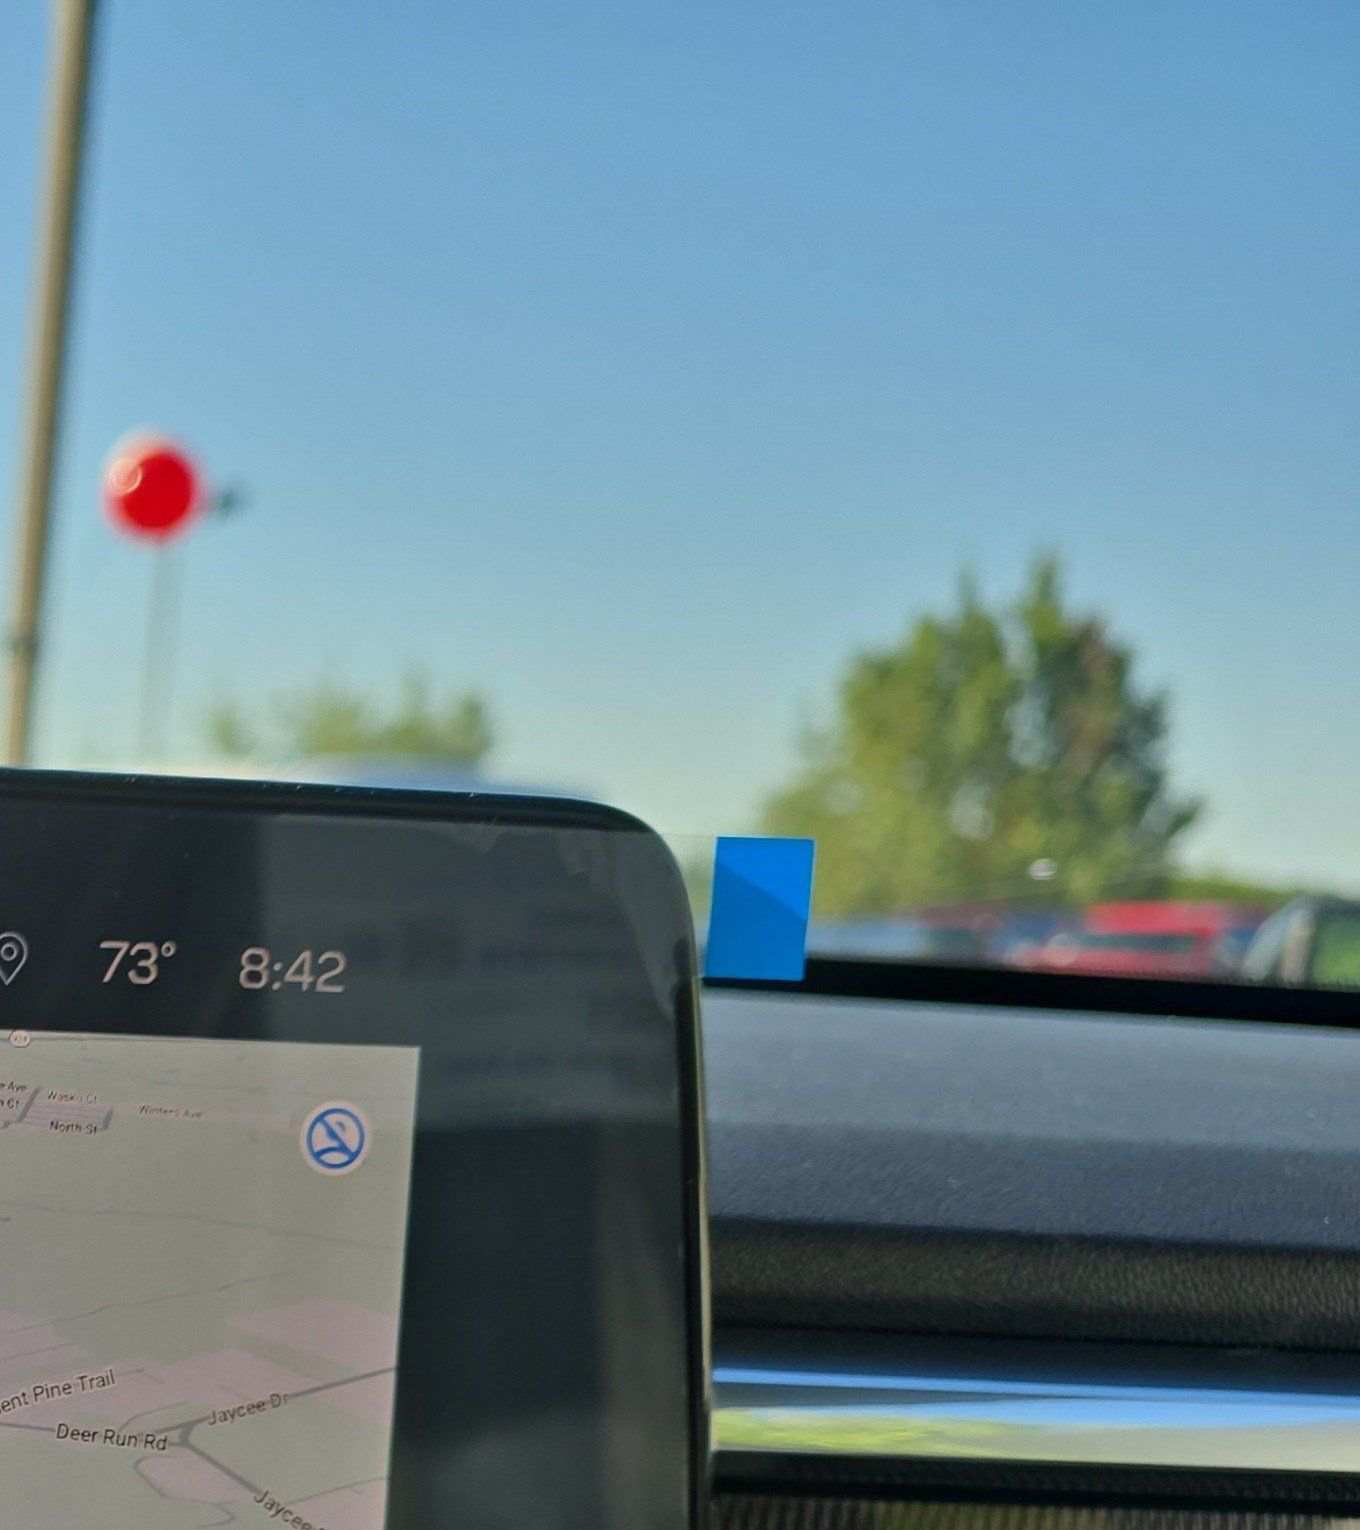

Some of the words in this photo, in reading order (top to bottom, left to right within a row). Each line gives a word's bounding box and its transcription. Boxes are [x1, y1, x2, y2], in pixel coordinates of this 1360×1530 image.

[99, 940, 177, 985] 73°
[239, 947, 348, 993] 8:42
[50, 1121, 81, 1132] North
[85, 1123, 97, 1134] St
[33, 1382, 74, 1402] Pine
[78, 1370, 116, 1391] Trail
[208, 1400, 267, 1427] Jaycee
[270, 1393, 290, 1410] Dr
[56, 1423, 99, 1443] Deer
[103, 1428, 139, 1449] Run
[143, 1433, 168, 1451] Rd
